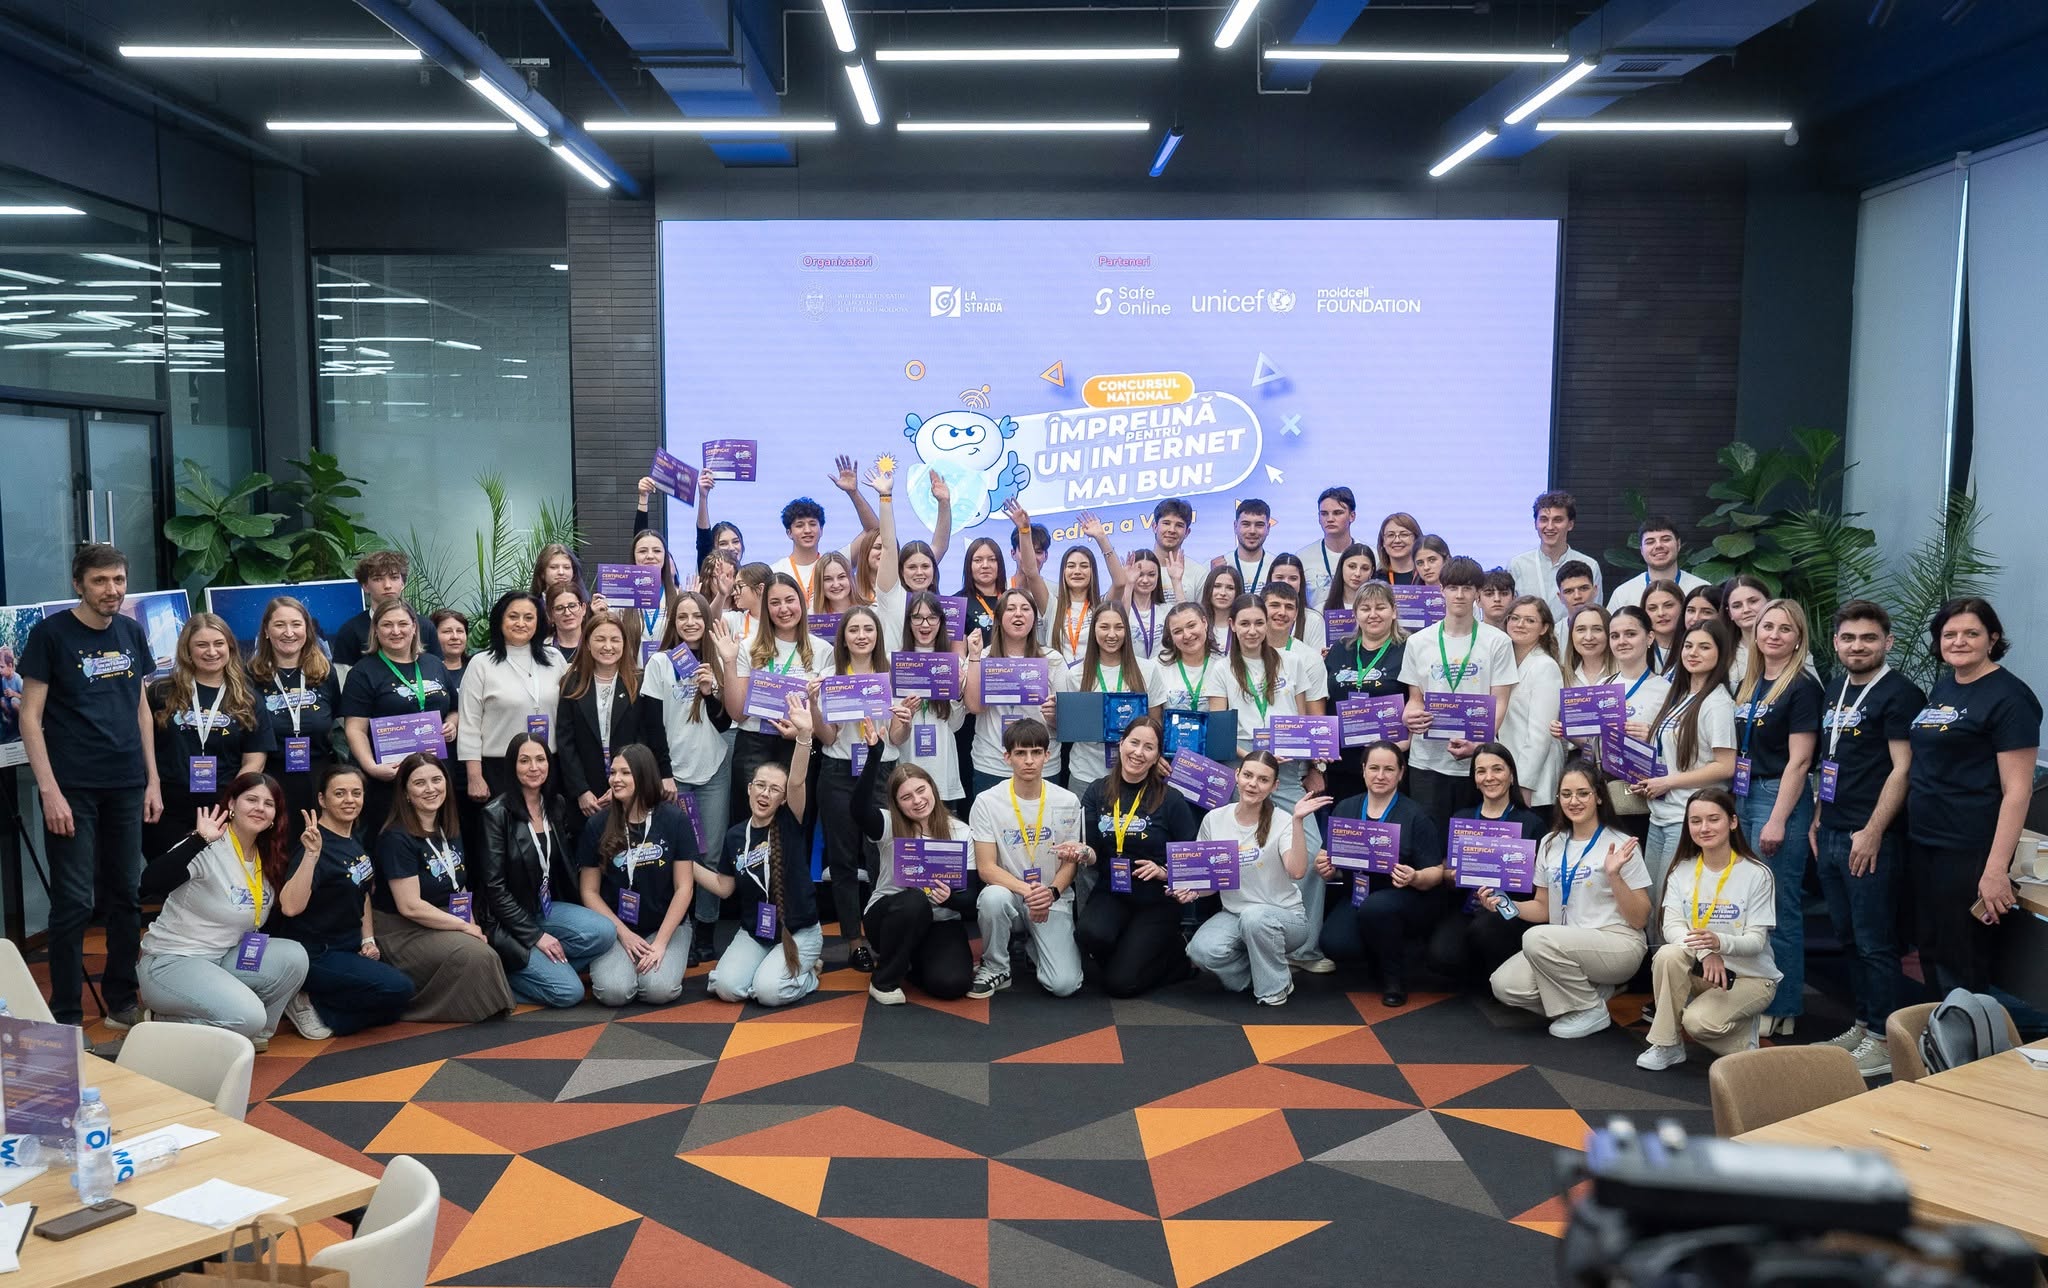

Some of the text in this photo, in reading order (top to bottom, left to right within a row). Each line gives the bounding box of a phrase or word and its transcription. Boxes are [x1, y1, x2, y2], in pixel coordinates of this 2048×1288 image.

[803, 256, 873, 269] Organizatori
[1098, 256, 1151, 267] Parteneri
[965, 291, 976, 301] LA
[1118, 286, 1155, 299] Safe
[1317, 286, 1370, 298] moldcell
[1191, 288, 1267, 313] unicef
[1317, 299, 1421, 313] FOUNDATION
[965, 303, 1003, 313] STRADA
[1118, 301, 1171, 315] Online
[1098, 378, 1180, 391] CONCURSUL
[1049, 396, 1217, 445] ÎMPREUNĂ
[1125, 425, 1182, 443] PENTRU
[1037, 428, 1246, 476] UN INTERNET
[1068, 462, 1213, 502] MAI BUN!
[1119, 519, 1134, 533] a
[1333, 828, 1363, 836] CERTIFICAT
[1463, 846, 1495, 854] CERTIFICAT
